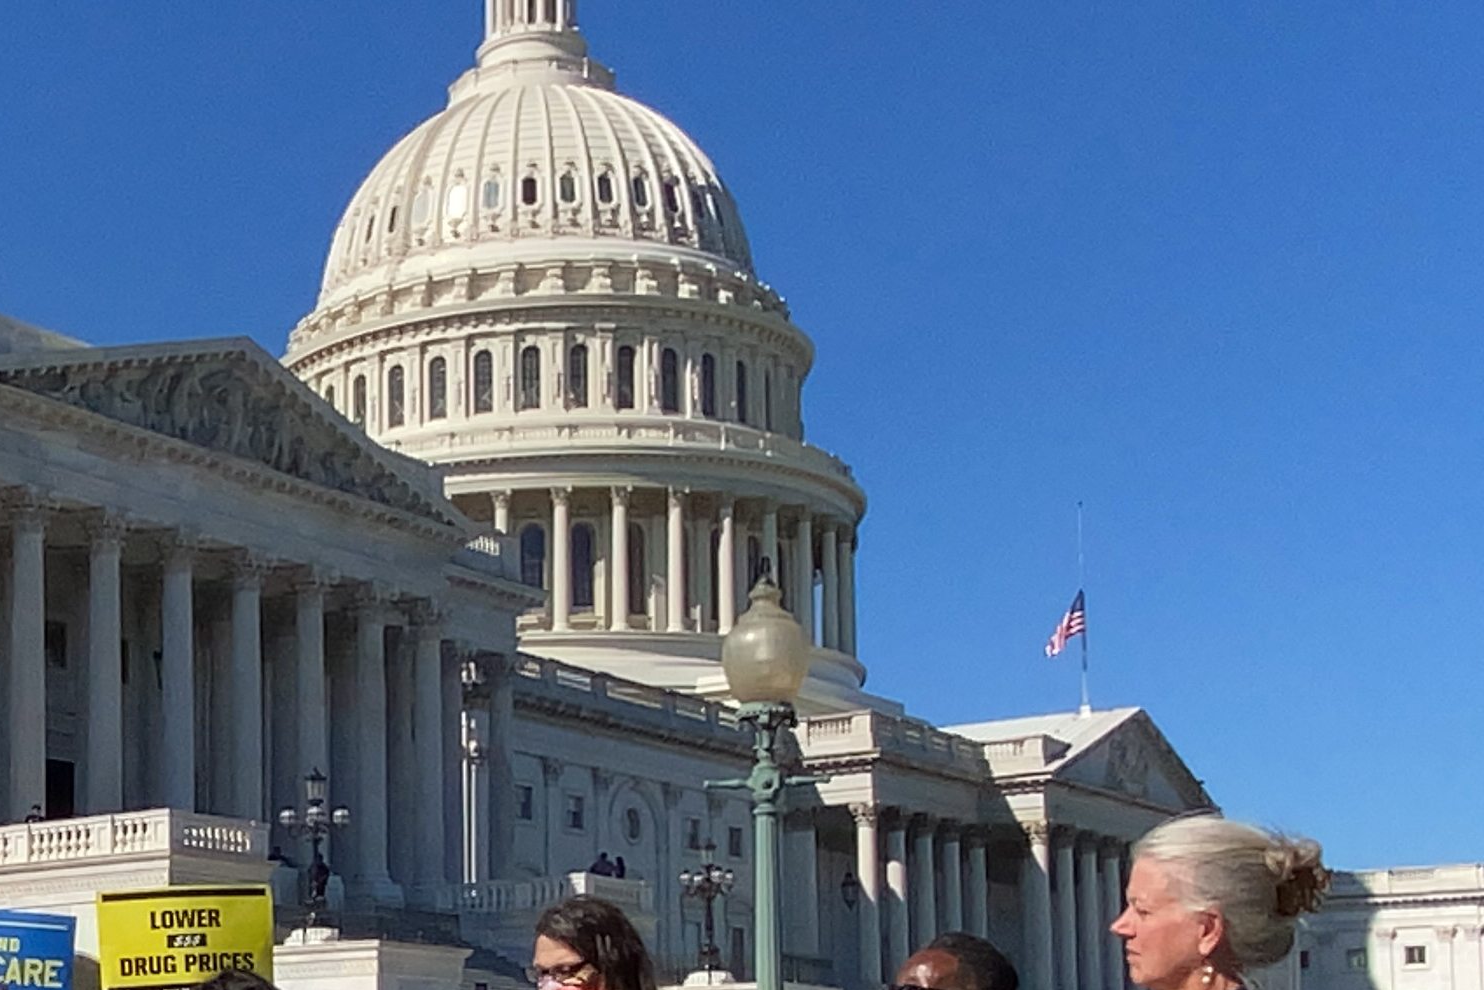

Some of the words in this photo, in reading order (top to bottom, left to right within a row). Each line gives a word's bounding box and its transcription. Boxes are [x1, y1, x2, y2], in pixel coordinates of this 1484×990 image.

[150, 908, 221, 930] LOWER
[119, 954, 178, 977] DRUG
[184, 952, 255, 973] PRICES
